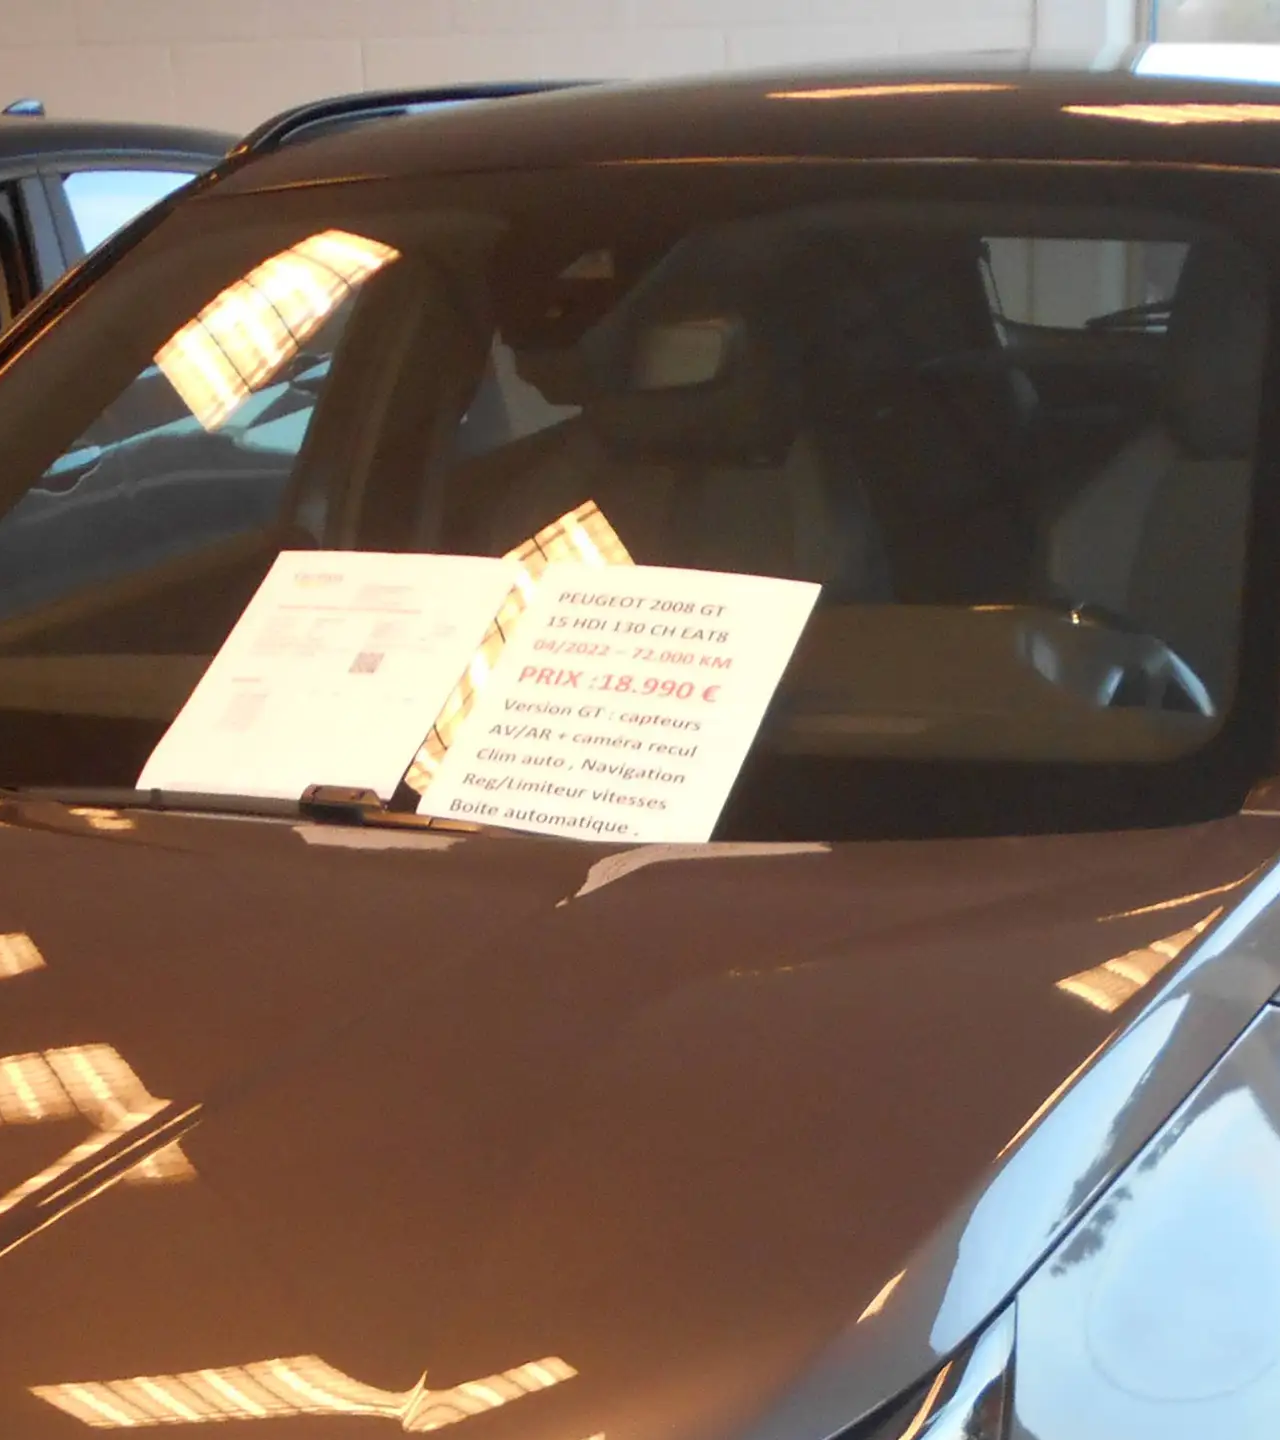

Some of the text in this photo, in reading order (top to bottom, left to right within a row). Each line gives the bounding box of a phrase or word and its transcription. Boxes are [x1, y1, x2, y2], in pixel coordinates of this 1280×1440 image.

[558, 592, 726, 617] PEUGEOT 2008 GT
[573, 618, 607, 631] HDI
[612, 620, 645, 634] 130
[650, 624, 677, 637] CH
[680, 627, 729, 643] EAT8
[698, 654, 732, 669] KM
[518, 665, 583, 688] PRIX
[702, 685, 721, 702] €
[504, 698, 572, 717] Version
[577, 706, 604, 720] GT
[619, 712, 701, 732] capteurs
[489, 724, 552, 741] AV/AR
[648, 743, 697, 759] recul
[476, 748, 517, 763] Clim
[522, 755, 565, 769] auto
[581, 758, 685, 784] Navigation
[592, 788, 667, 811] vitesses
[503, 808, 628, 834] automatique
